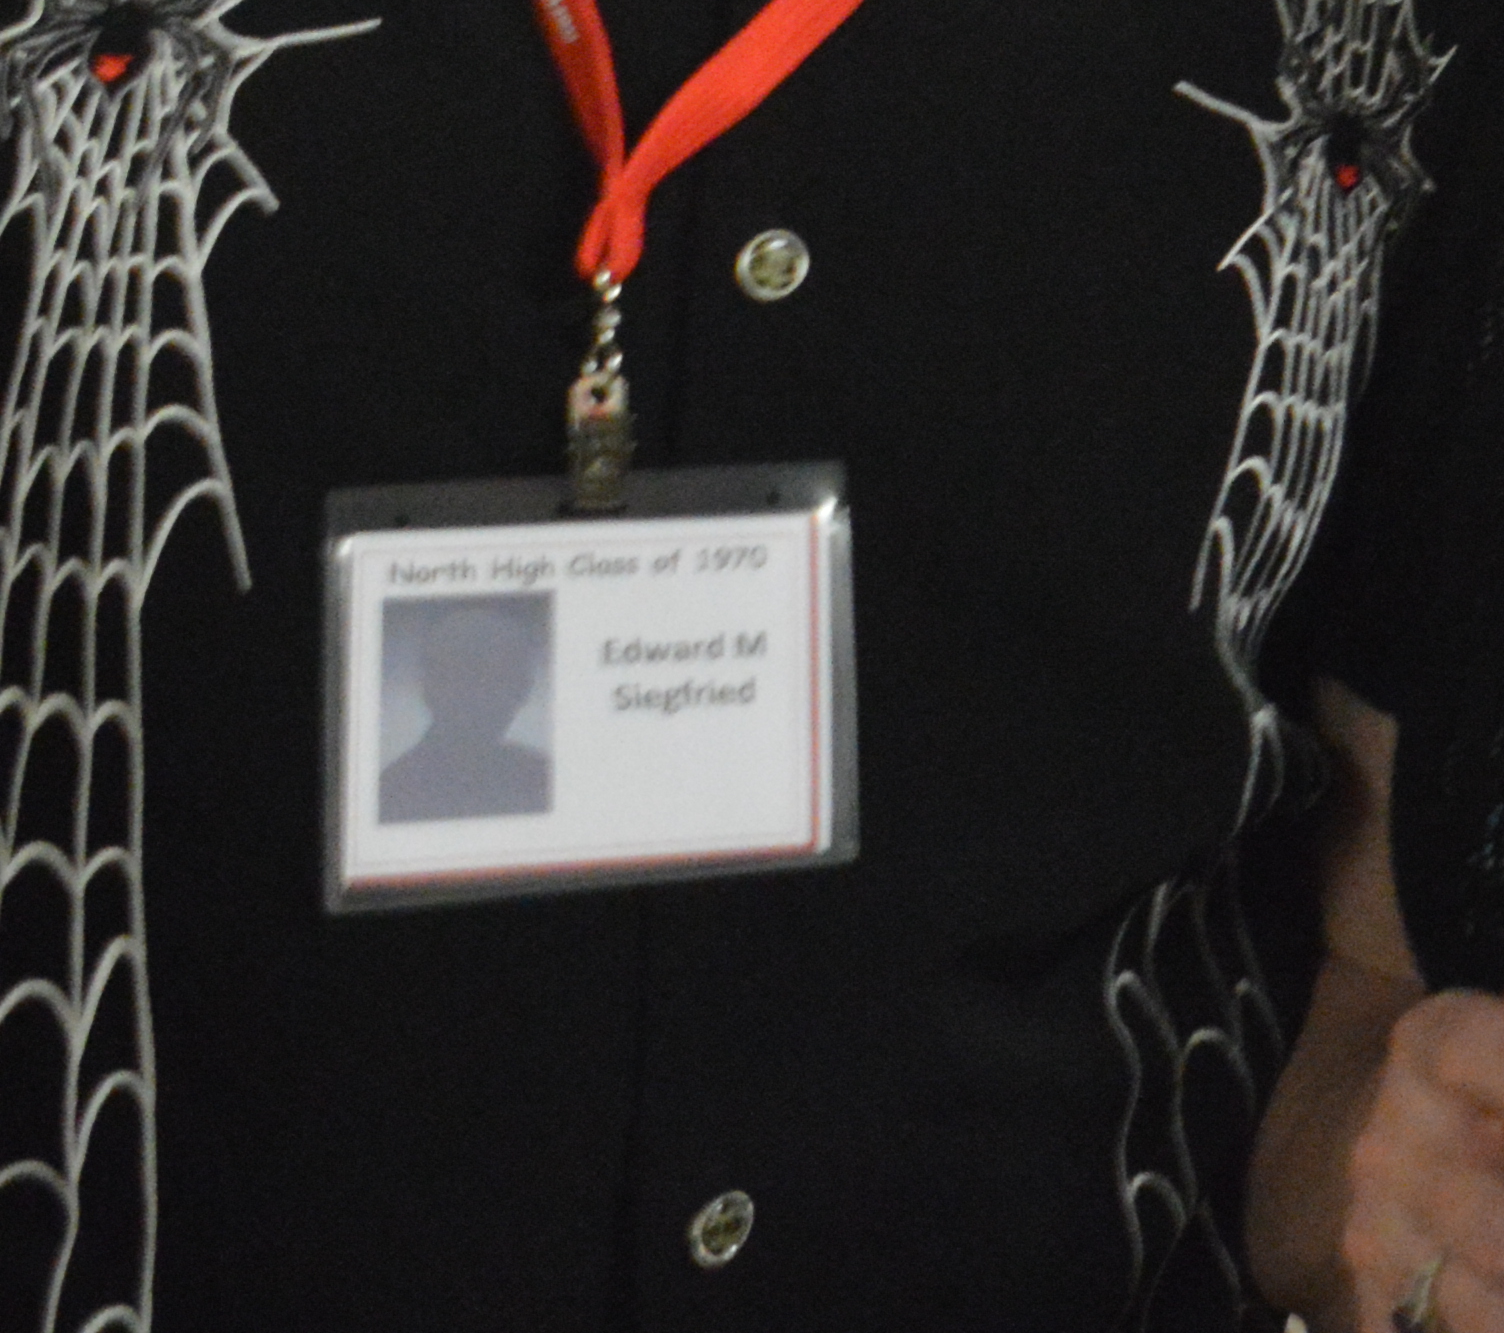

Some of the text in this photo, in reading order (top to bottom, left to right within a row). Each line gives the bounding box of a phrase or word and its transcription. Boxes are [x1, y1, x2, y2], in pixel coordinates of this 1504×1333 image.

[390, 544, 768, 587] North High Class of 1970
[602, 631, 768, 666] Edward M
[612, 679, 756, 714] Siegfried
